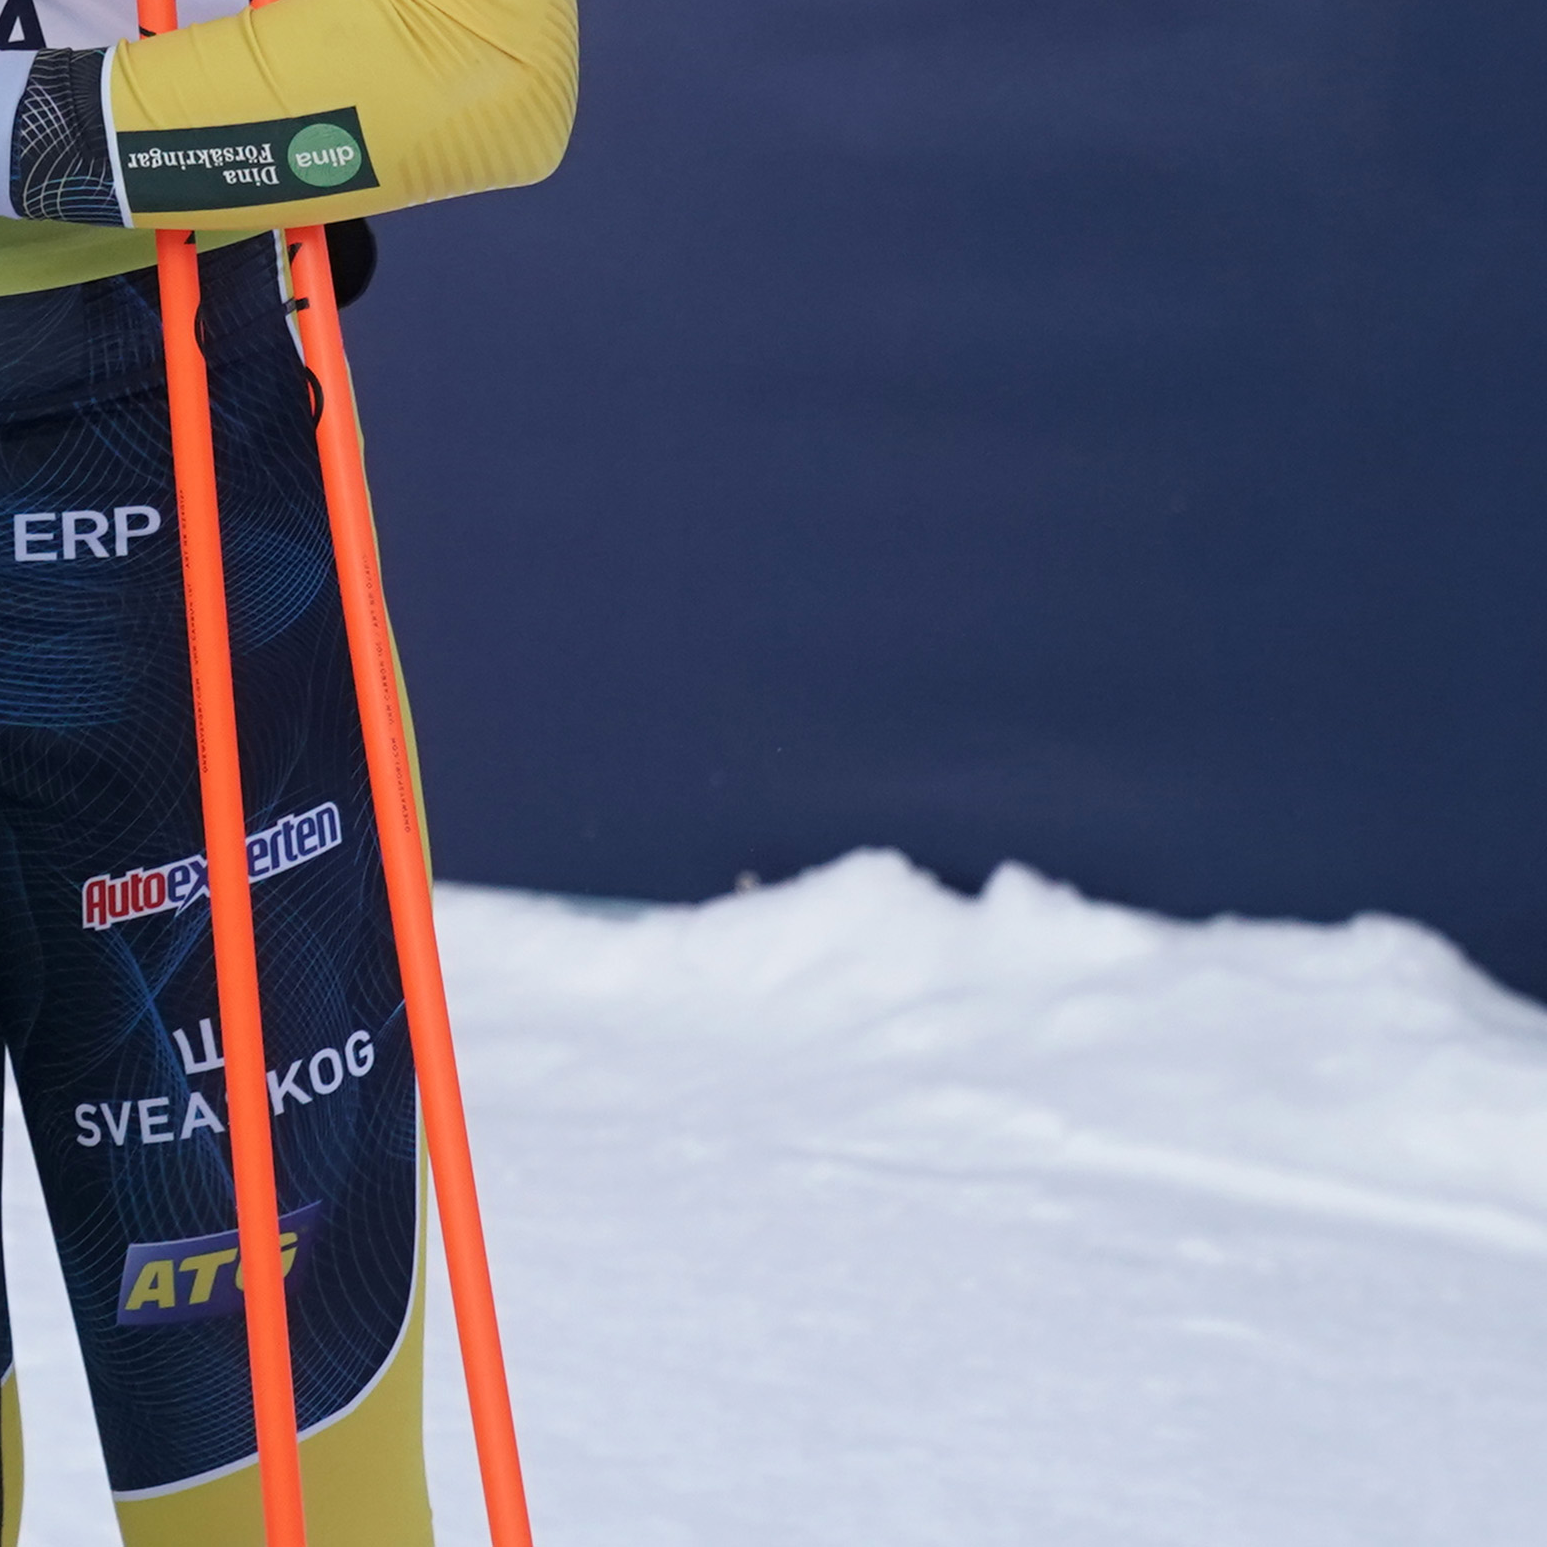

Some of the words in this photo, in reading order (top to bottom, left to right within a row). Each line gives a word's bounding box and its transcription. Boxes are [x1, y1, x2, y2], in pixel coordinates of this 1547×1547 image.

[127, 142, 275, 171] Försäkringar
[222, 165, 280, 186] Dina
[295, 144, 355, 169] dina
[15, 507, 162, 565] ERP
[84, 804, 340, 925] Autoexerten
[75, 1028, 376, 1148] SVEAKOG
